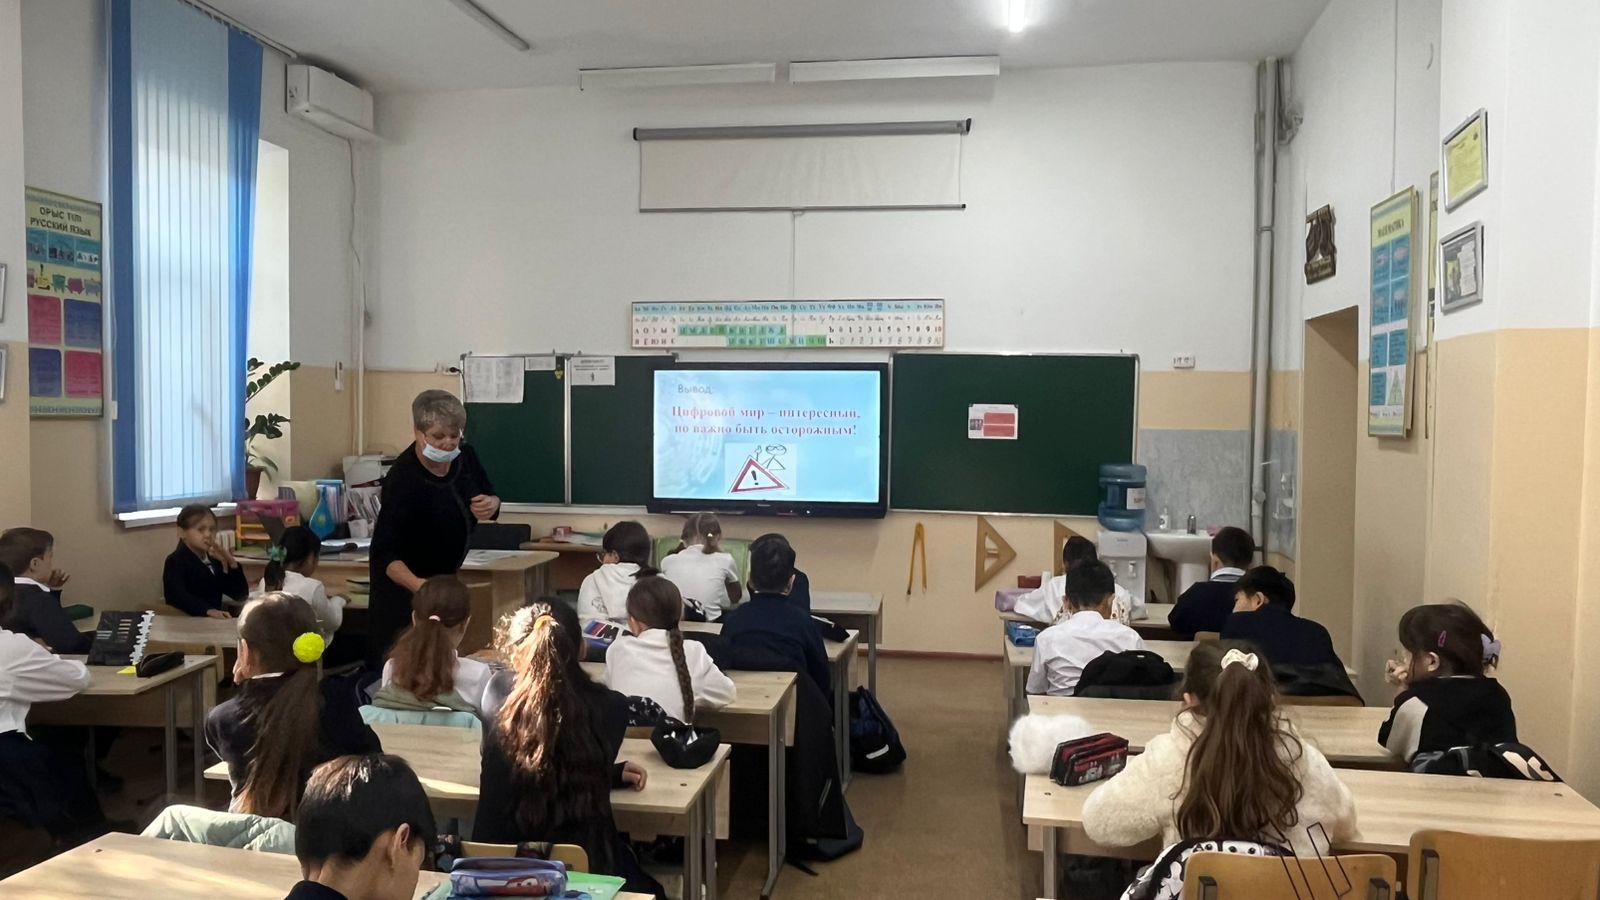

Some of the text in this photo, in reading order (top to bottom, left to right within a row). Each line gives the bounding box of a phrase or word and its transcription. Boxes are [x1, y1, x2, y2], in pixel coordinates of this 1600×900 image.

[40, 206, 65, 220] ОРЫС
[30, 216, 92, 236] РУССКИЙ ЯЗЫК
[672, 405, 736, 419] Цифровой
[740, 409, 765, 420] мир
[675, 423, 857, 437] но важно быть осторожным!
